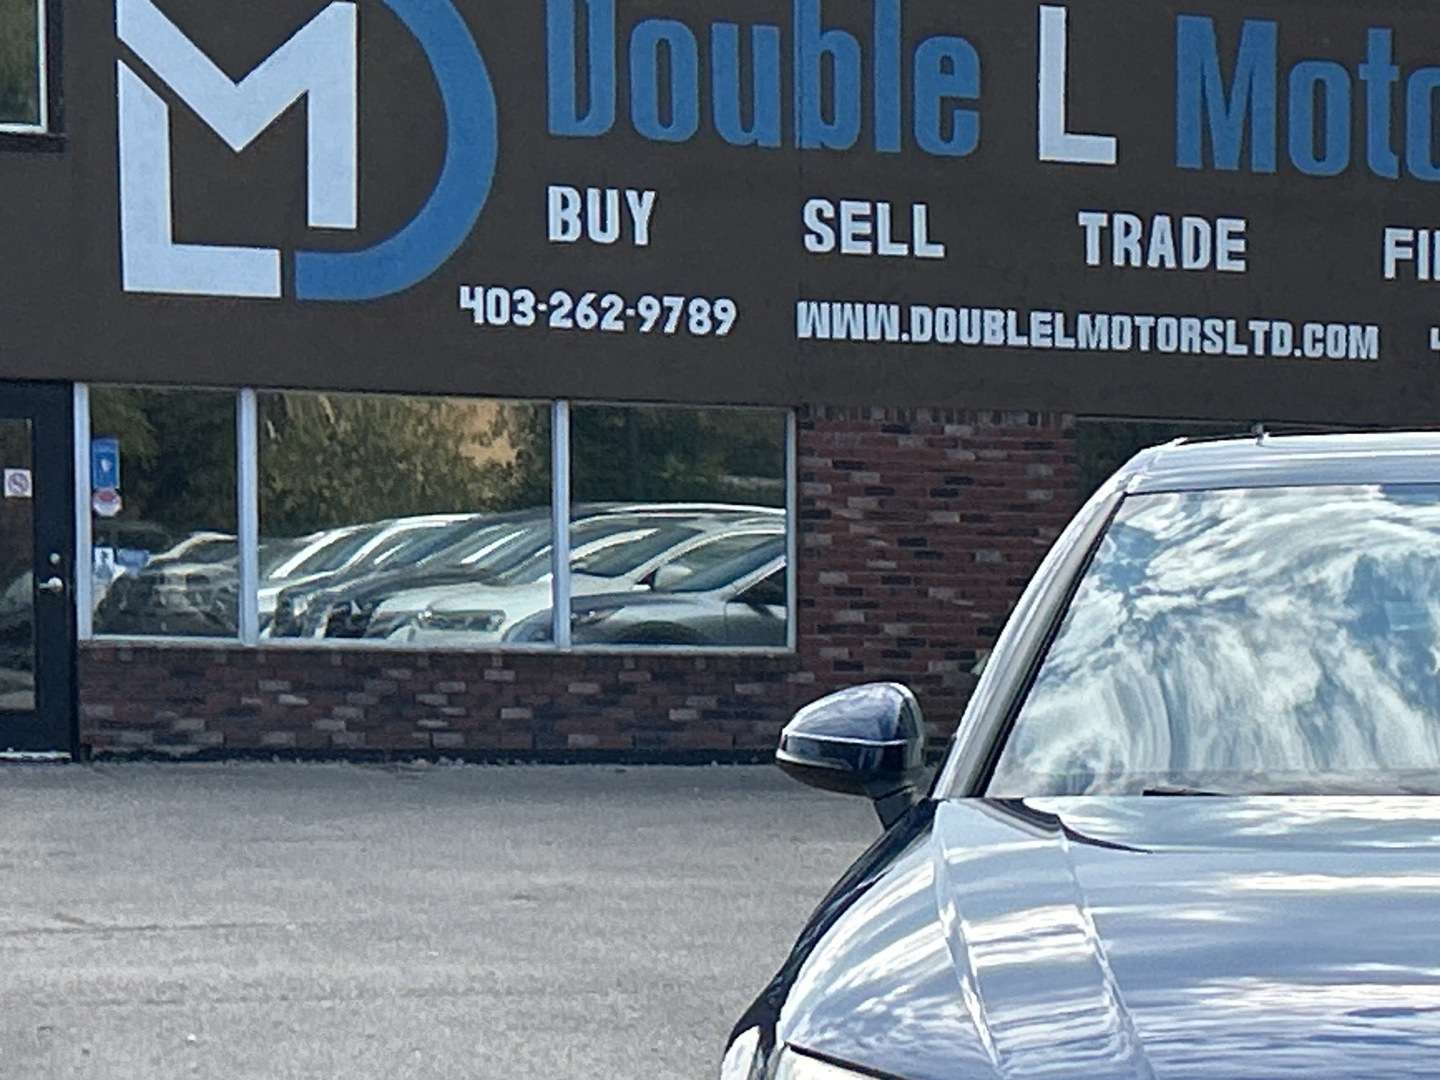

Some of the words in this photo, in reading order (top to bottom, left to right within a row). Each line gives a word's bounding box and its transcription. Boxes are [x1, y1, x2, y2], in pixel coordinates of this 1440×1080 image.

[545, 0, 982, 157] Double
[1038, 5, 1117, 165] L
[547, 185, 657, 247] BUY
[803, 198, 946, 259] SELL
[1077, 211, 1247, 273] TRADE
[458, 284, 738, 336] 403-262-9789
[796, 300, 1380, 360] WWW.DOUBLELMOTORSLTD.COM
